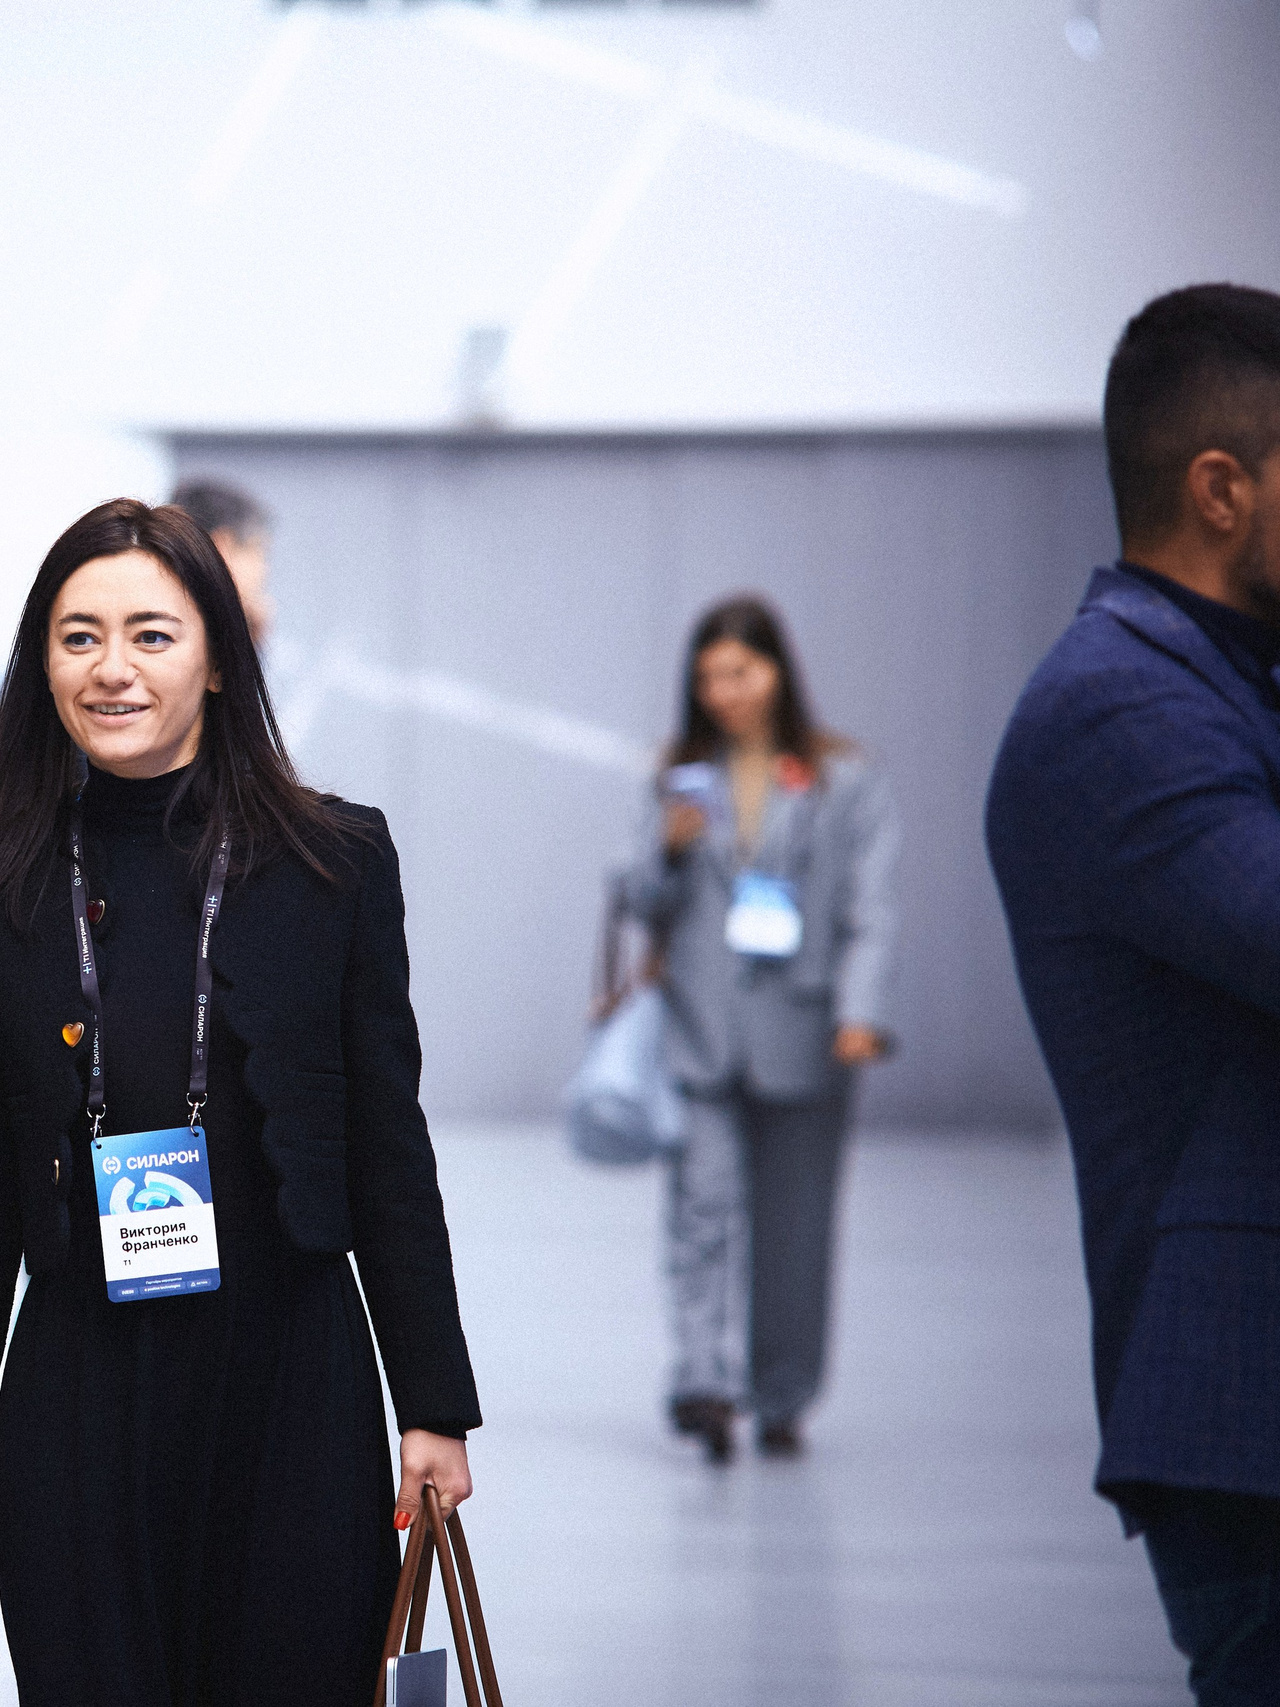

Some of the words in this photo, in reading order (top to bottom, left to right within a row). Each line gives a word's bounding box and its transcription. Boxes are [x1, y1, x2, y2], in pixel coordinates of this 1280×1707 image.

[79, 916, 89, 954] Интеграция
[201, 917, 213, 959] Интеграция
[196, 1005, 206, 1042] СИЛАРОН
[126, 1149, 200, 1170] СИЛАРОН
[120, 1222, 186, 1240] Виктория
[122, 1233, 199, 1254] Франченко
